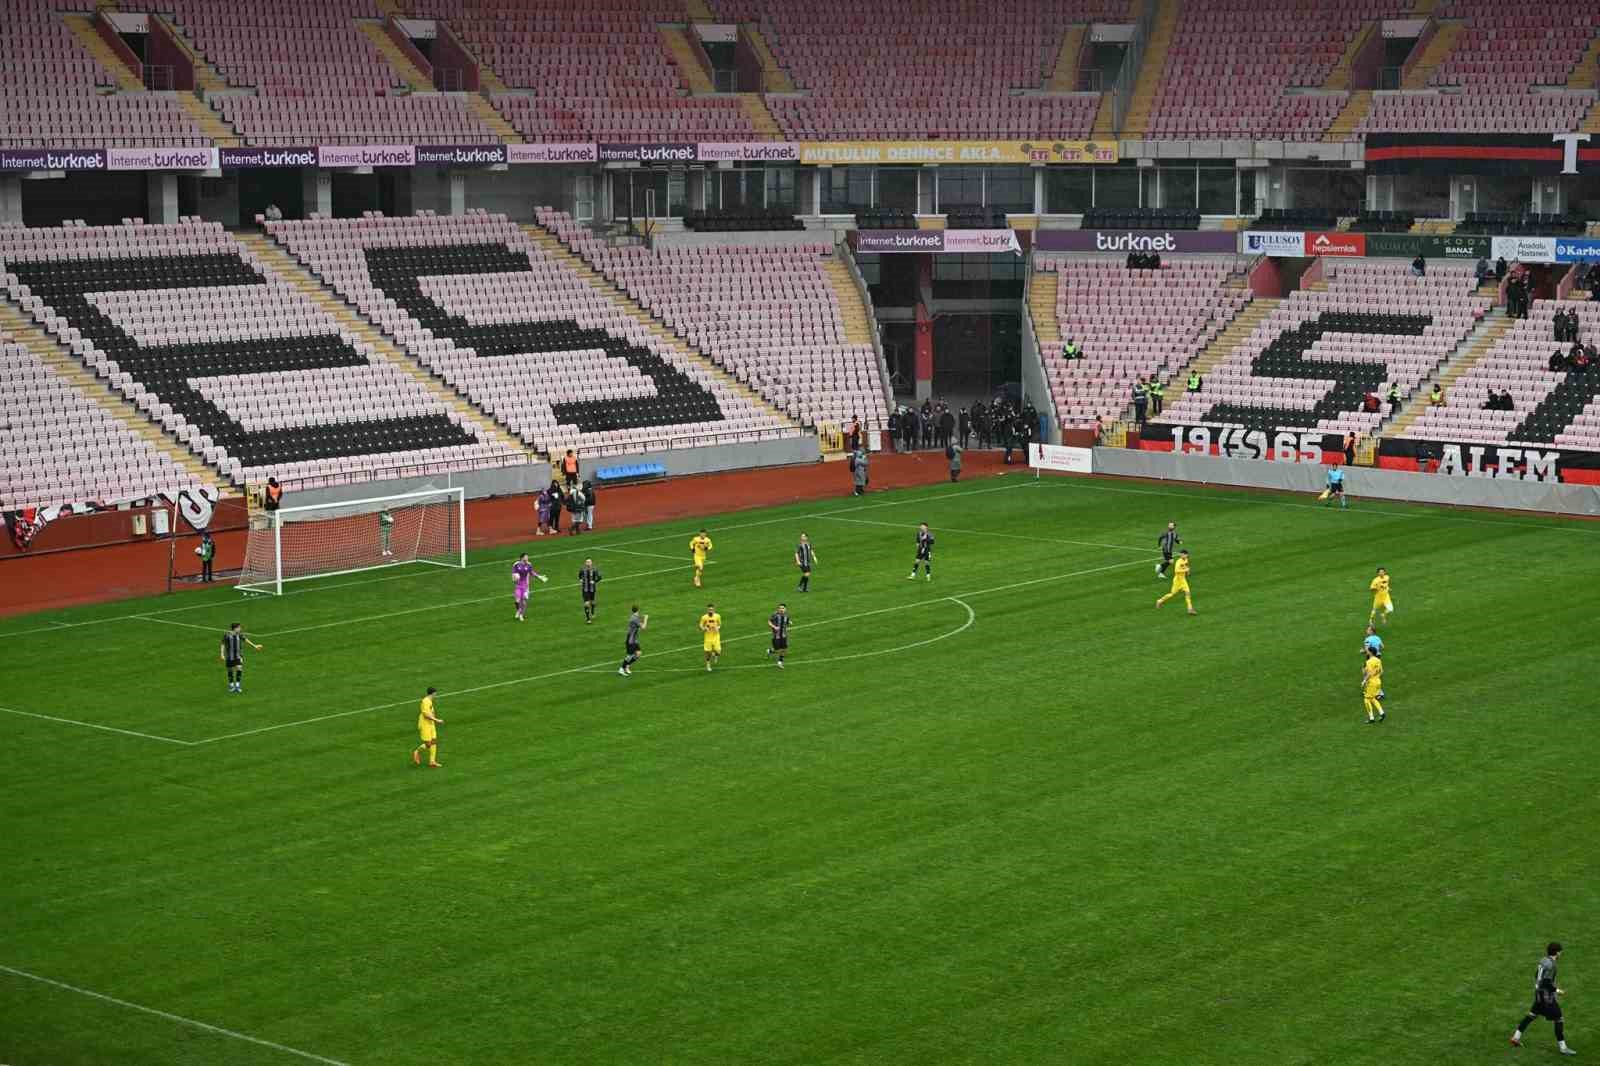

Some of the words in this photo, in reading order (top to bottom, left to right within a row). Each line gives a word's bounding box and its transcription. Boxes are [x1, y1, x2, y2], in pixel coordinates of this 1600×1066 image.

[264, 151, 316, 165] turknet
[363, 151, 411, 163] turknet
[456, 148, 504, 162] turknet
[547, 148, 594, 160] turknet
[640, 146, 695, 160] turknet
[743, 146, 796, 159] turknet
[1552, 133, 1591, 174] T
[47, 153, 104, 168] turknet
[154, 153, 207, 167] turknet
[896, 234, 942, 246] turknet
[1097, 232, 1176, 250] turknet
[1437, 444, 1561, 484] ALEM
